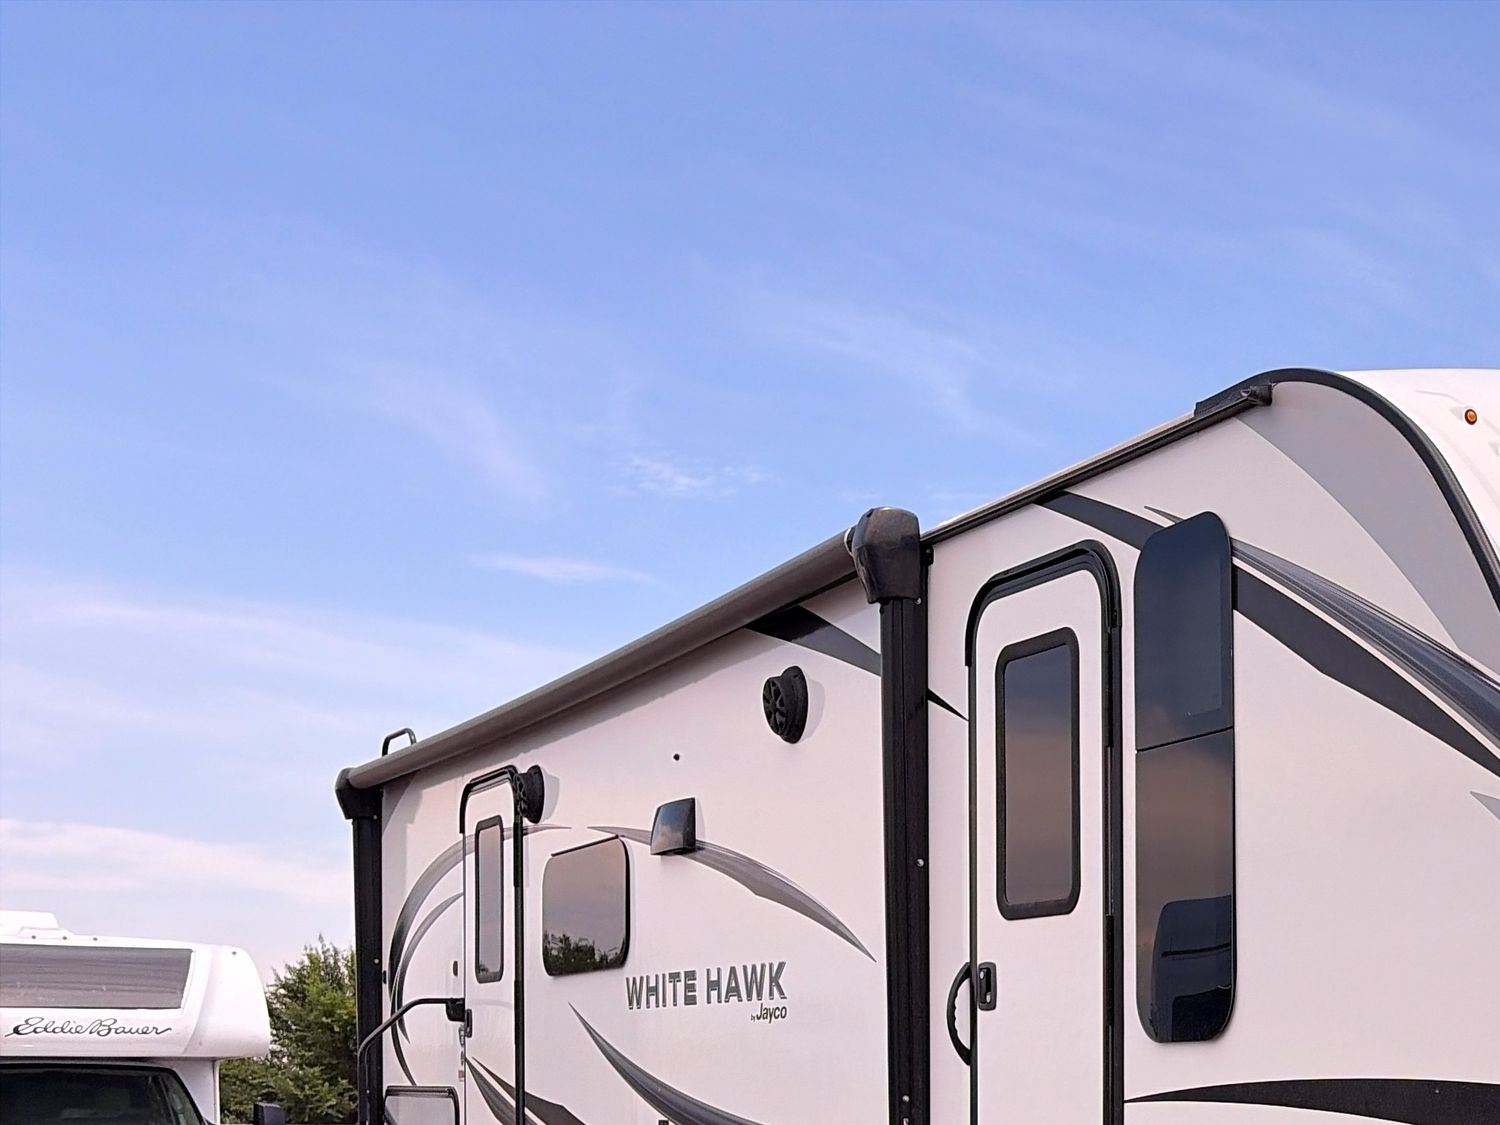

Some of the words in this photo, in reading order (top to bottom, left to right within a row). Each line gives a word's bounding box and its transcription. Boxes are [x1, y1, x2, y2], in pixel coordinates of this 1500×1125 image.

[626, 970, 697, 1010] WHITE
[706, 961, 788, 1005] HAWK
[756, 1003, 788, 1024] Jayco
[5, 1017, 87, 1037] Eddie
[88, 1018, 172, 1037] Bauer
